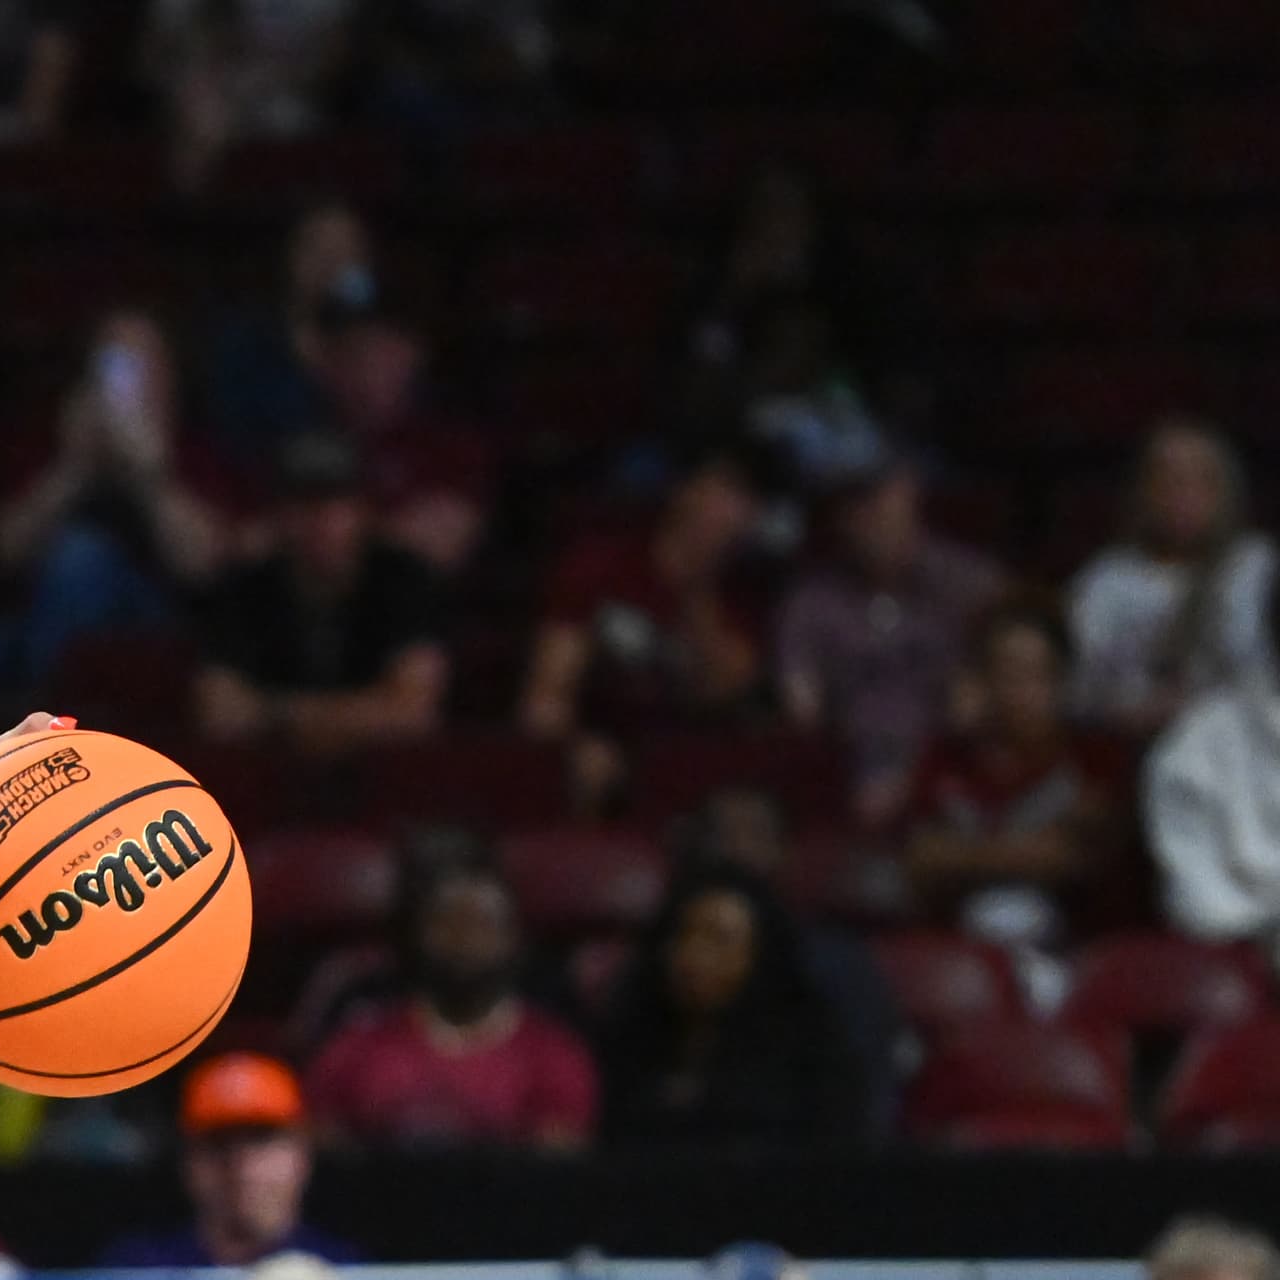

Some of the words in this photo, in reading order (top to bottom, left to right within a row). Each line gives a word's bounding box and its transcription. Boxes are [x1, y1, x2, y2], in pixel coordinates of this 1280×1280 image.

[7, 767, 71, 822] MARCH
[92, 827, 123, 852] EVO
[60, 848, 90, 877] NXT
